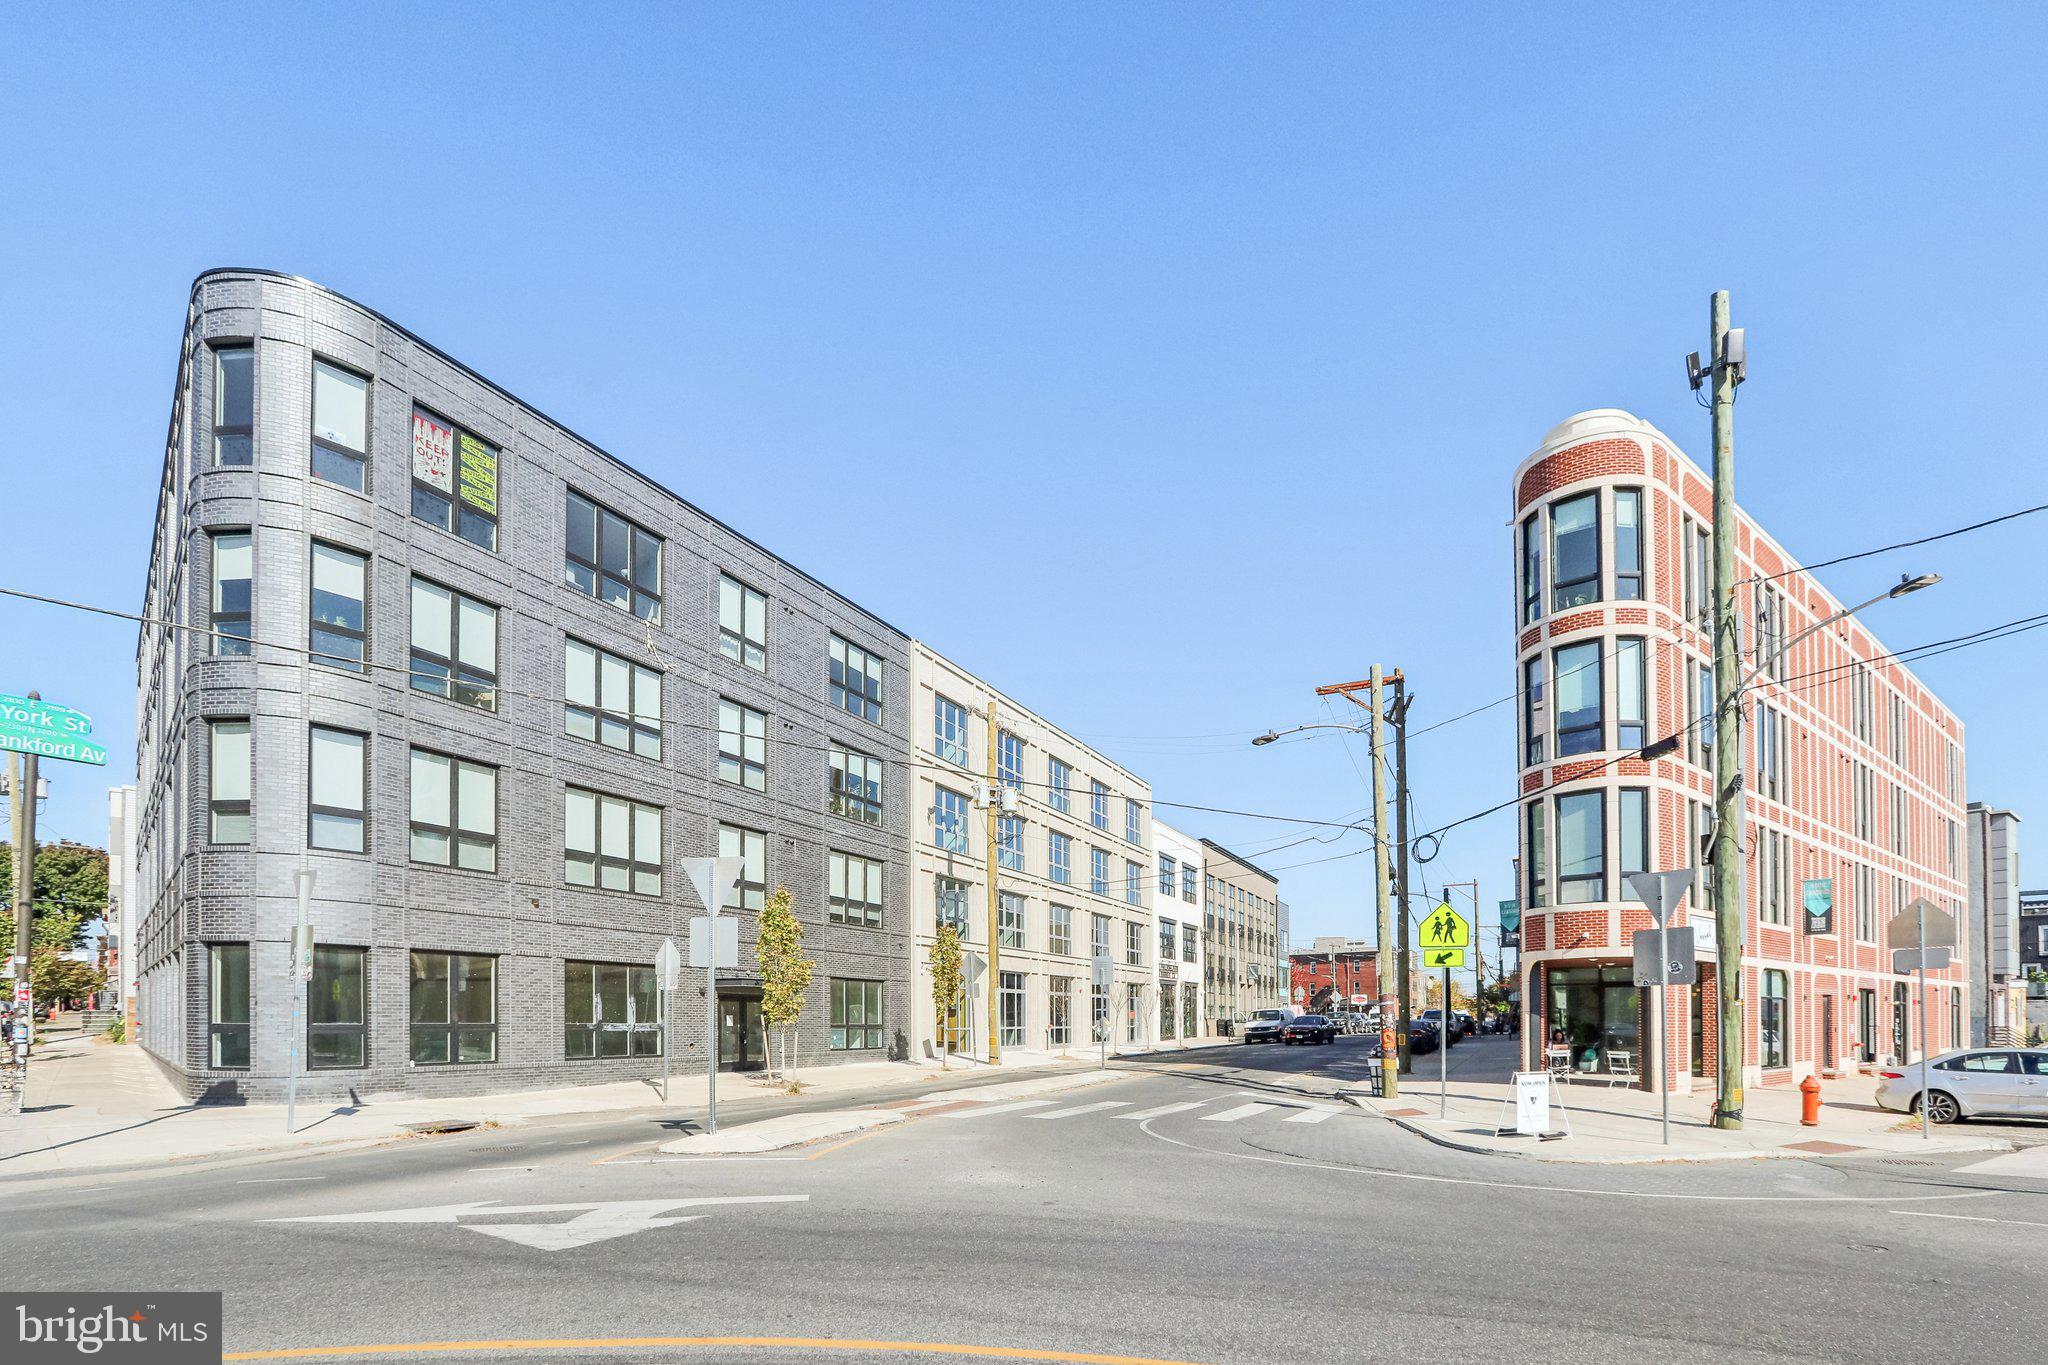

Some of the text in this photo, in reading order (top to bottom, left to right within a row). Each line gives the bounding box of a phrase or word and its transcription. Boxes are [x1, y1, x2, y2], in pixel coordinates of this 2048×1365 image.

[415, 433, 449, 458] KEEP
[30, 700, 39, 709] E
[0, 703, 88, 734] York St
[80, 747, 106, 762] Av
